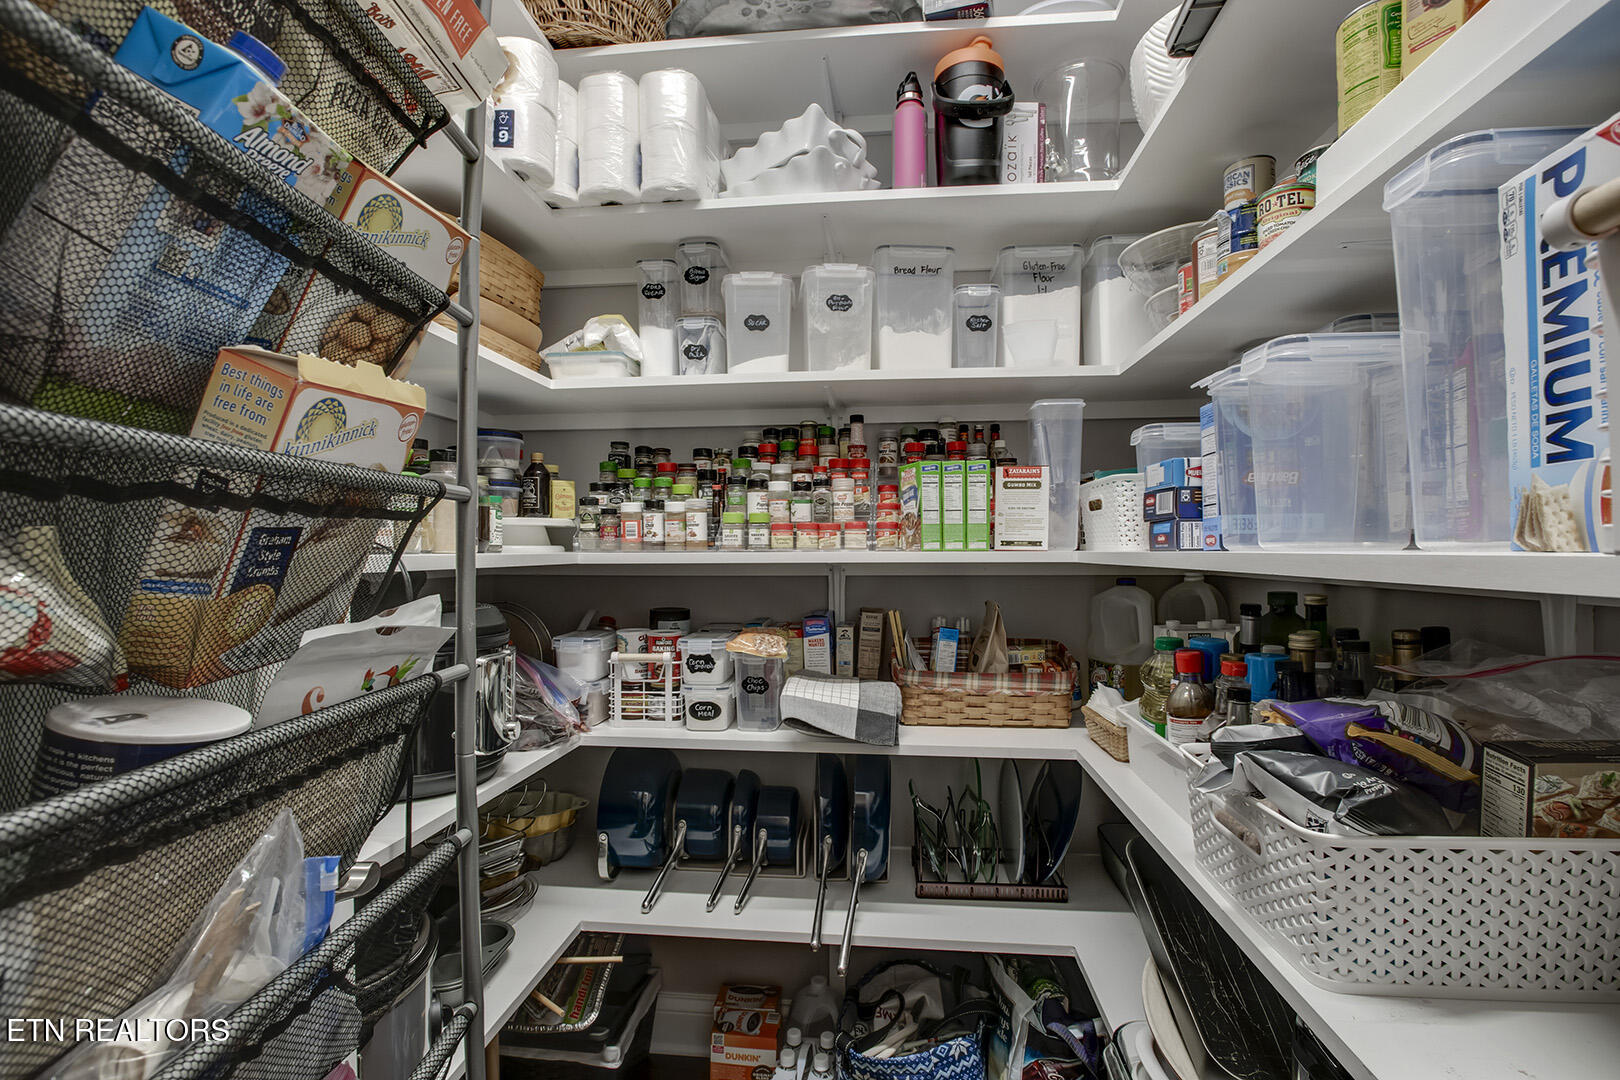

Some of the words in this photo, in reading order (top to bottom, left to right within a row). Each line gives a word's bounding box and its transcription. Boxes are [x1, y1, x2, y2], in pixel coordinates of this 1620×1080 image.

[449, 9, 473, 44] FREE
[498, 130, 509, 143] 9
[232, 126, 314, 176] Almond
[893, 266, 916, 275] Bread
[920, 265, 942, 275] Flour
[1032, 272, 1055, 283] Flour
[1541, 146, 1595, 465] PEMIUM
[221, 362, 248, 382] Best
[249, 374, 285, 399] things
[1530, 359, 1538, 411] GALLETAS
[219, 379, 231, 393] in
[233, 384, 253, 402] life
[255, 396, 275, 412] are
[213, 394, 237, 413] free
[239, 403, 267, 426] from
[1531, 413, 1539, 428] DE
[284, 420, 378, 457] kinnikinnick
[1531, 430, 1540, 460] SODA
[258, 533, 292, 546] Graham
[258, 549, 282, 564] Style
[247, 565, 280, 578] Crumbs
[77, 752, 116, 764] kitchens
[80, 763, 113, 774] perfect
[1512, 784, 1526, 796] 130
[725, 1052, 761, 1062] DUNKIN'
